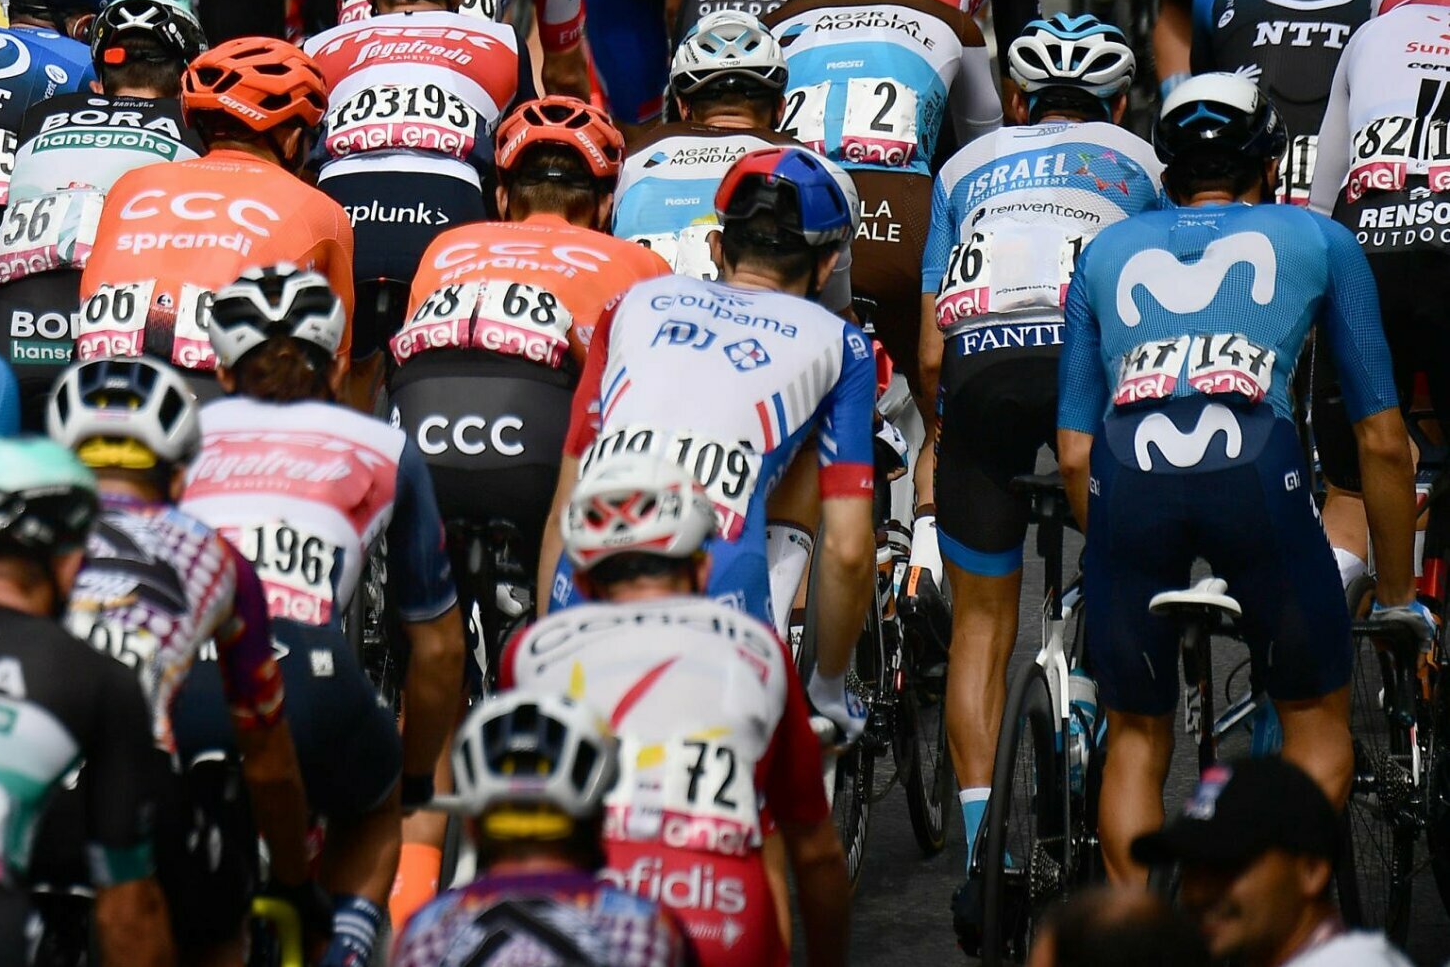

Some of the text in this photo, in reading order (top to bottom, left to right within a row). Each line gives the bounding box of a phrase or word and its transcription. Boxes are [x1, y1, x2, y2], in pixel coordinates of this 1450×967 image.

[814, 18, 937, 52] MONDIALE
[893, 12, 922, 32] LA
[1253, 21, 1350, 49] NTT
[319, 26, 499, 57] TREK
[347, 39, 474, 71] Segafredo
[217, 93, 269, 122] GIANT
[404, 84, 470, 129] 193
[869, 81, 898, 133] 2
[40, 110, 183, 141] BORA
[332, 123, 395, 155] enel
[402, 125, 469, 156] enel
[36, 131, 173, 156] hansgrohe
[669, 153, 738, 165] MONDIA
[674, 144, 747, 157] AG2R LA
[844, 140, 915, 169] enel
[967, 151, 1071, 204] ISRAEL
[1009, 177, 1070, 191] ACADEMY
[1349, 164, 1402, 202] enel
[3, 196, 56, 246] 56
[120, 189, 281, 237] CCC
[861, 199, 893, 219] LA
[989, 201, 1101, 224] reinvent.com
[1358, 201, 1450, 229] RENSO
[115, 230, 253, 258] sprandi
[434, 242, 611, 273] CCC
[440, 255, 578, 282] sprandi
[502, 282, 558, 328] 68
[649, 294, 799, 340] Groupama
[78, 330, 138, 360] enel
[395, 319, 460, 360] enel
[480, 324, 557, 366] enel
[650, 319, 718, 352] FDJ
[962, 323, 1066, 356] FANTI
[1195, 334, 1273, 373] 147
[417, 413, 526, 457] CCC
[253, 524, 327, 587] 196
[683, 740, 739, 812] 72
